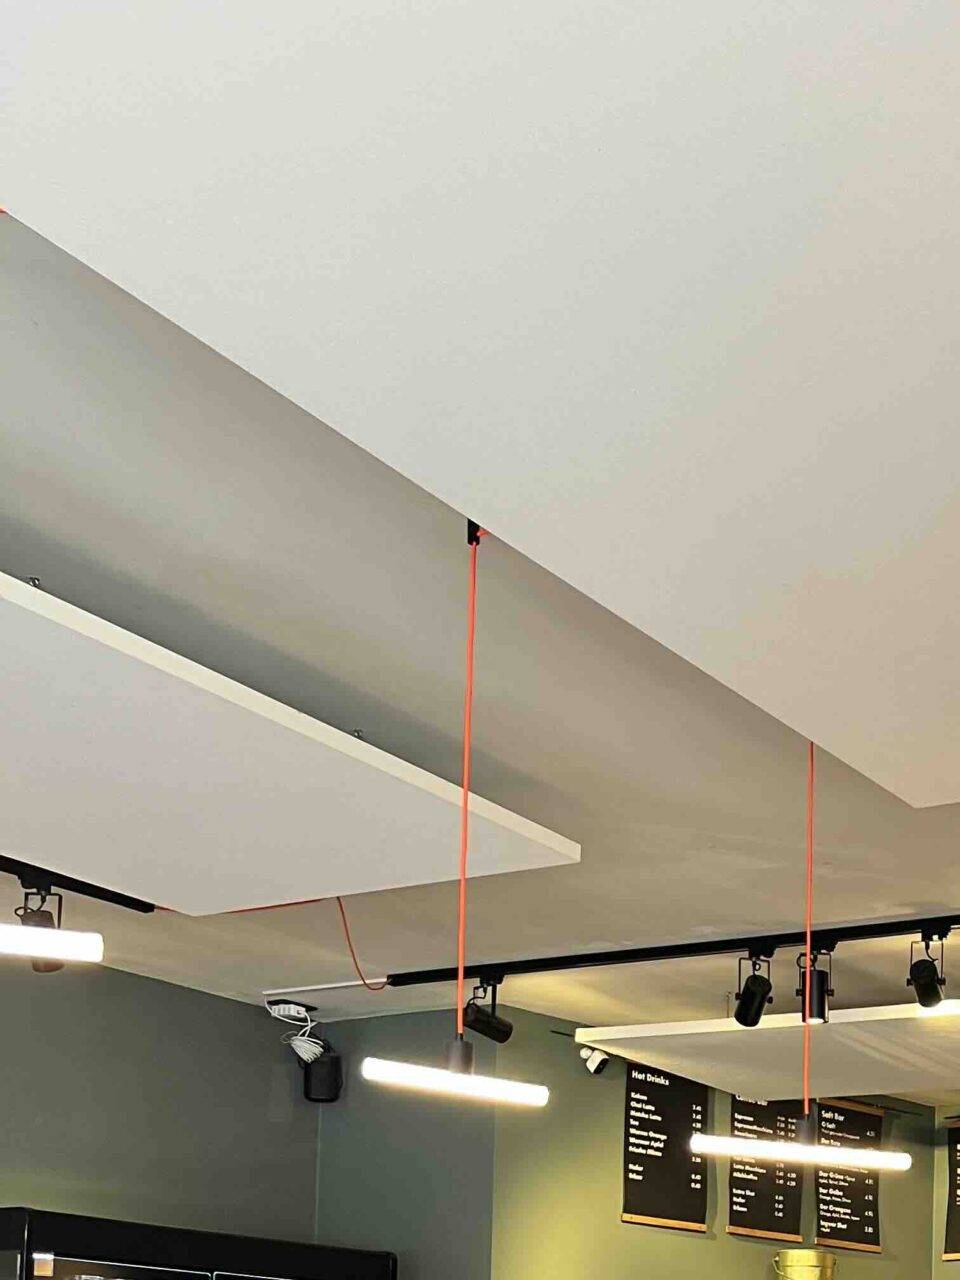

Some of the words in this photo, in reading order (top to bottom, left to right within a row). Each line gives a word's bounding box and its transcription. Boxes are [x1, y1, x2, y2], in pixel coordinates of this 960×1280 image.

[632, 1070, 645, 1080] Hot
[647, 1074, 669, 1085] Drinks
[835, 1113, 844, 1121] Bar
